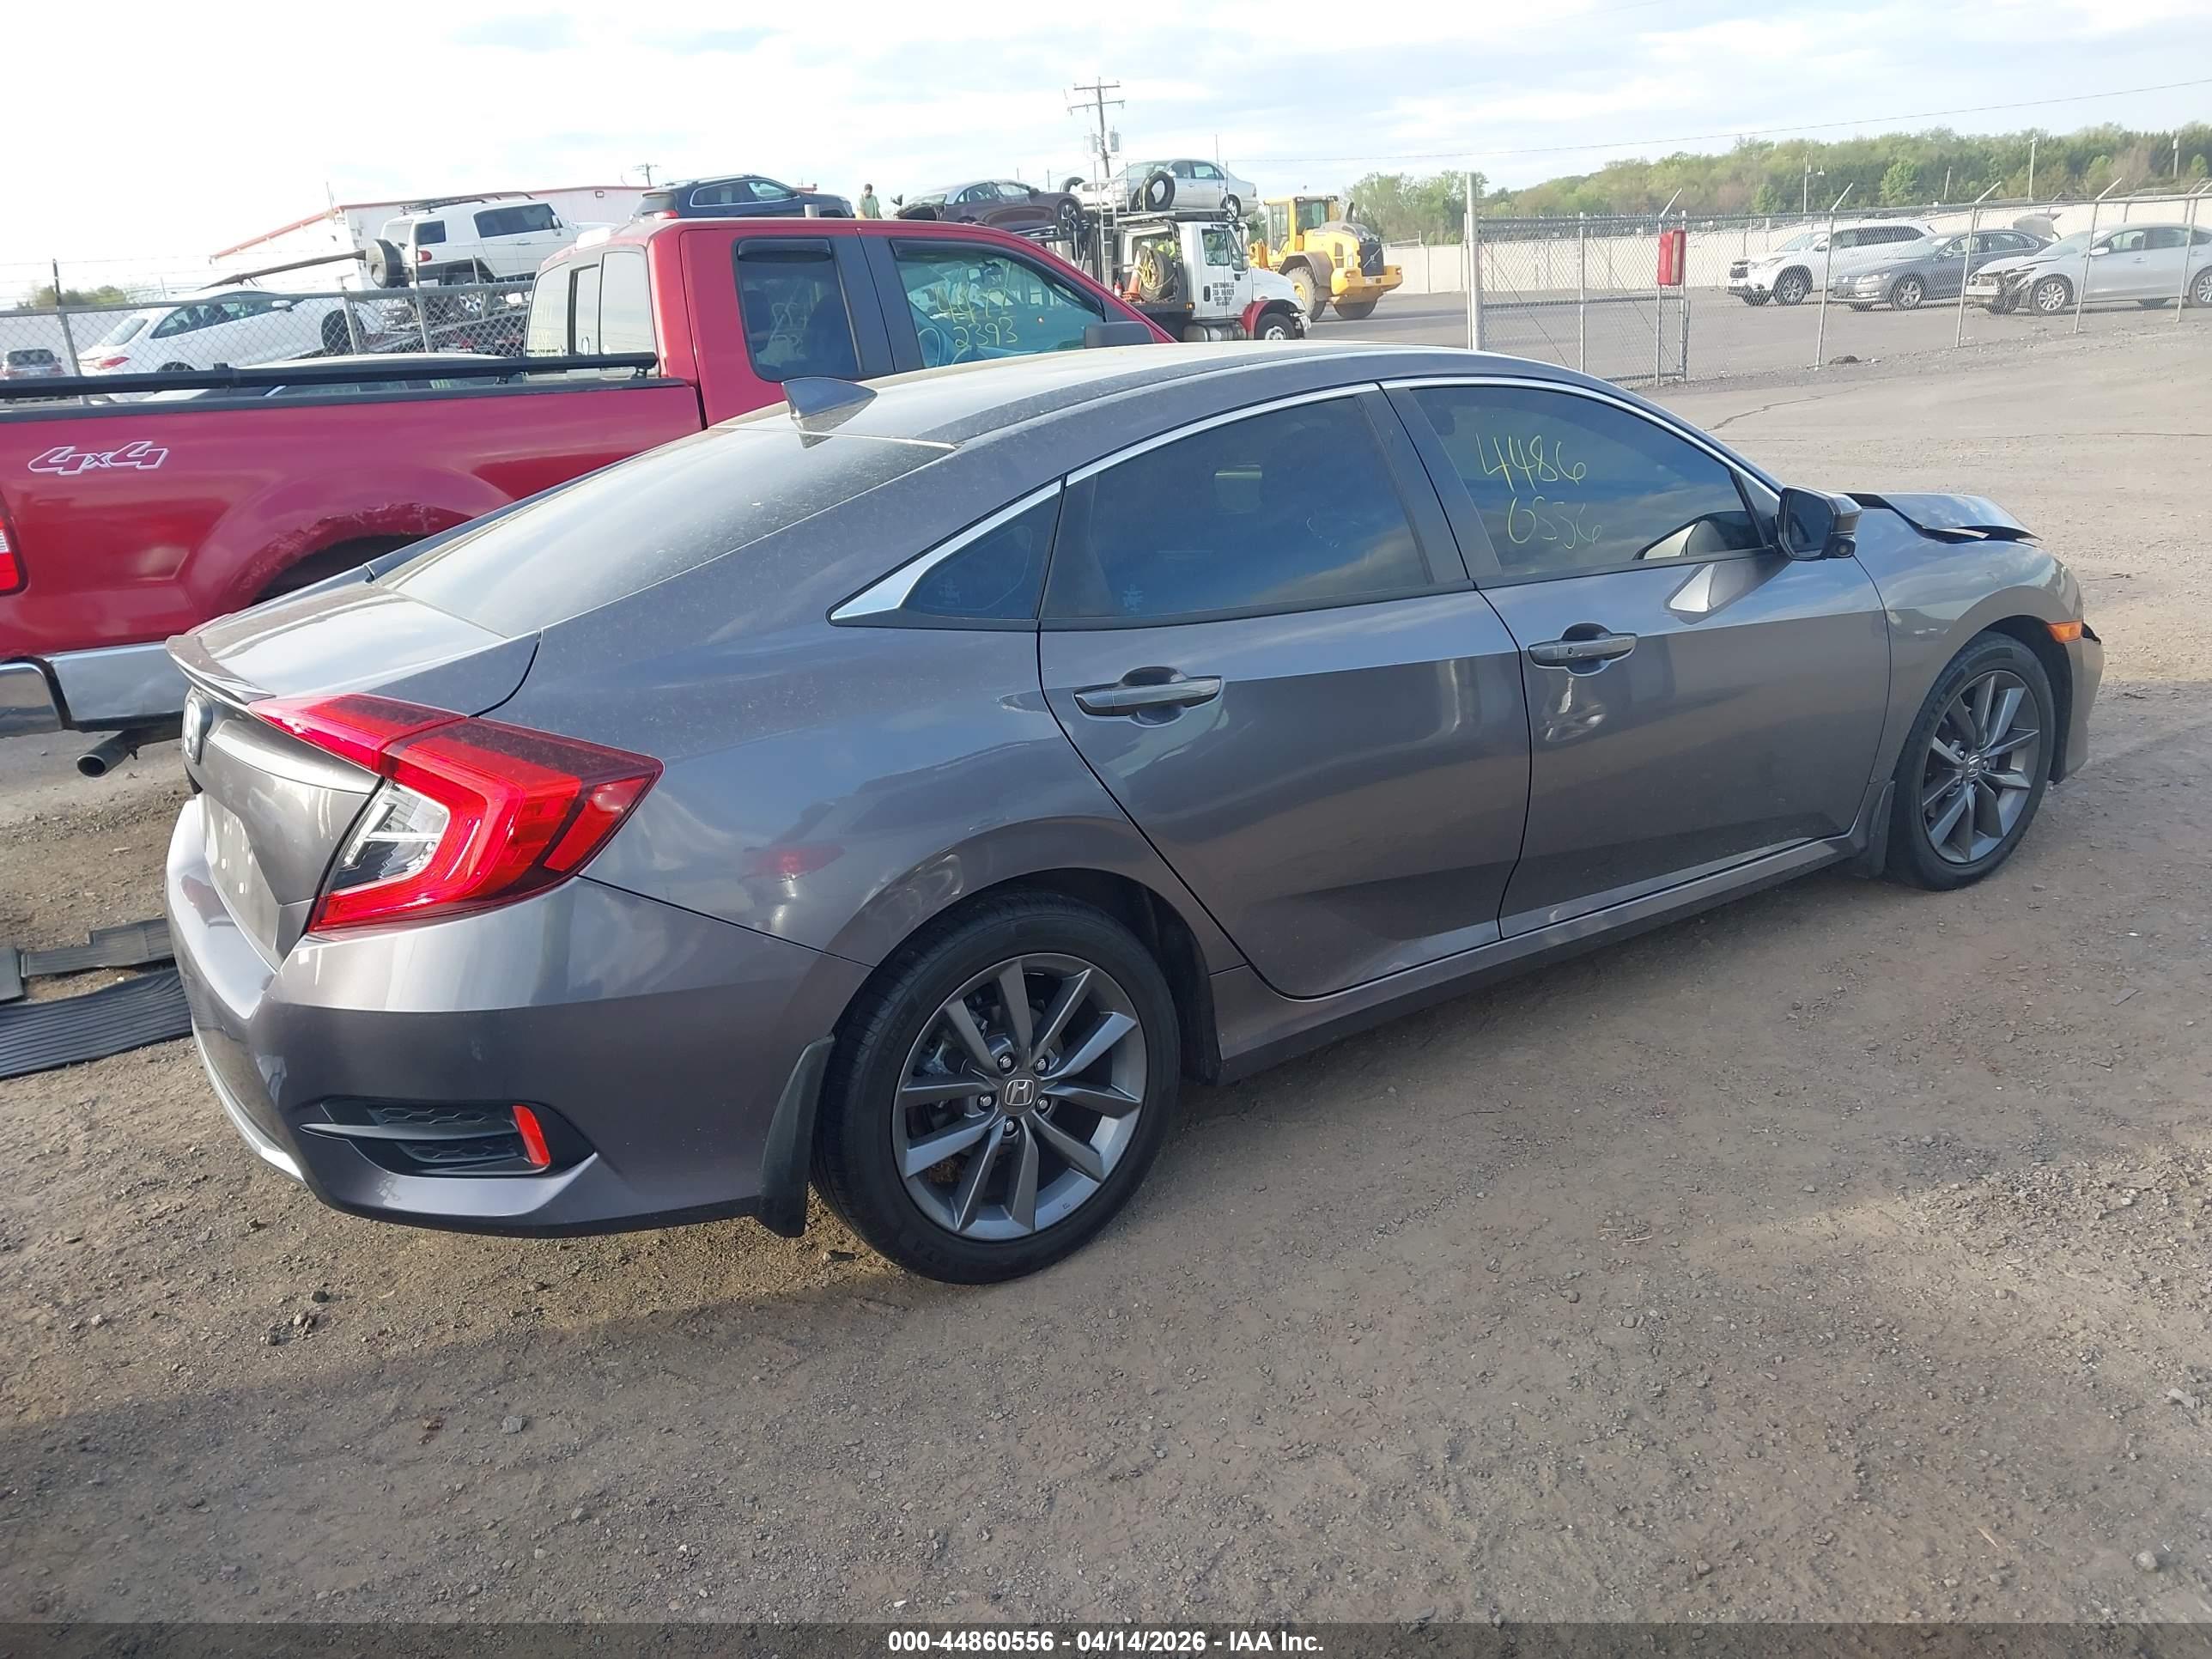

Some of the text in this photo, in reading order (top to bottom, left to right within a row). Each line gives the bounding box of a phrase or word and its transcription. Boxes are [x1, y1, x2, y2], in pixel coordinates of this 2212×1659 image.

[953, 317, 1018, 347] 2393
[27, 441, 169, 476] 4x4
[1475, 433, 1587, 493] 4486
[1508, 495, 1602, 550] 0556
